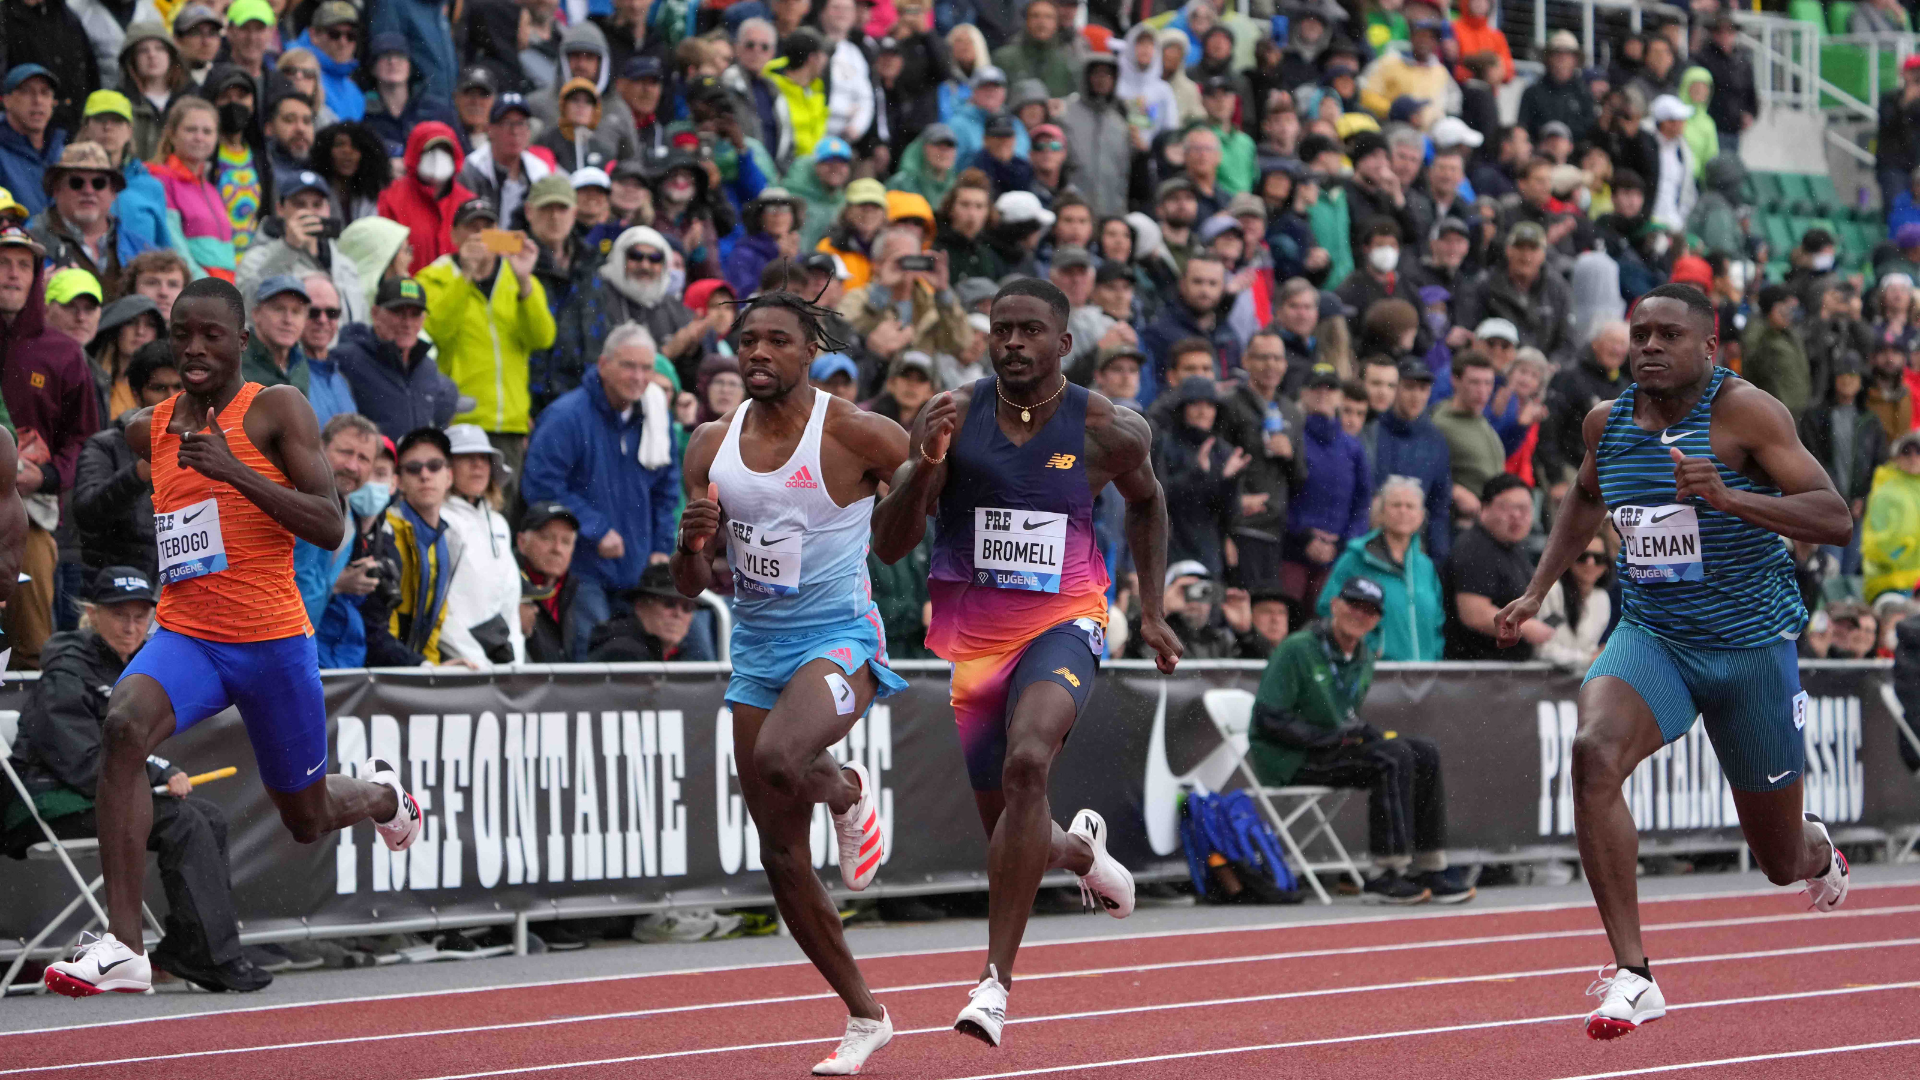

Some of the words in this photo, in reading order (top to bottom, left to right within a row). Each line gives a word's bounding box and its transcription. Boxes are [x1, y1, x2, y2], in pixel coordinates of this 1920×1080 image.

[785, 480, 818, 489] adidas
[985, 510, 1012, 531] PRE
[1620, 508, 1644, 526] PRE
[732, 522, 753, 544] PRE
[160, 531, 209, 560] TEBOGO
[983, 539, 1056, 566] BROMELL
[169, 562, 204, 578] EUGENE
[743, 552, 780, 578] LYLES
[1635, 568, 1675, 579] EUGENE
[743, 580, 776, 596] EUGENE
[997, 574, 1038, 586] EUGENE
[336, 710, 687, 894] PREFONTAINE
